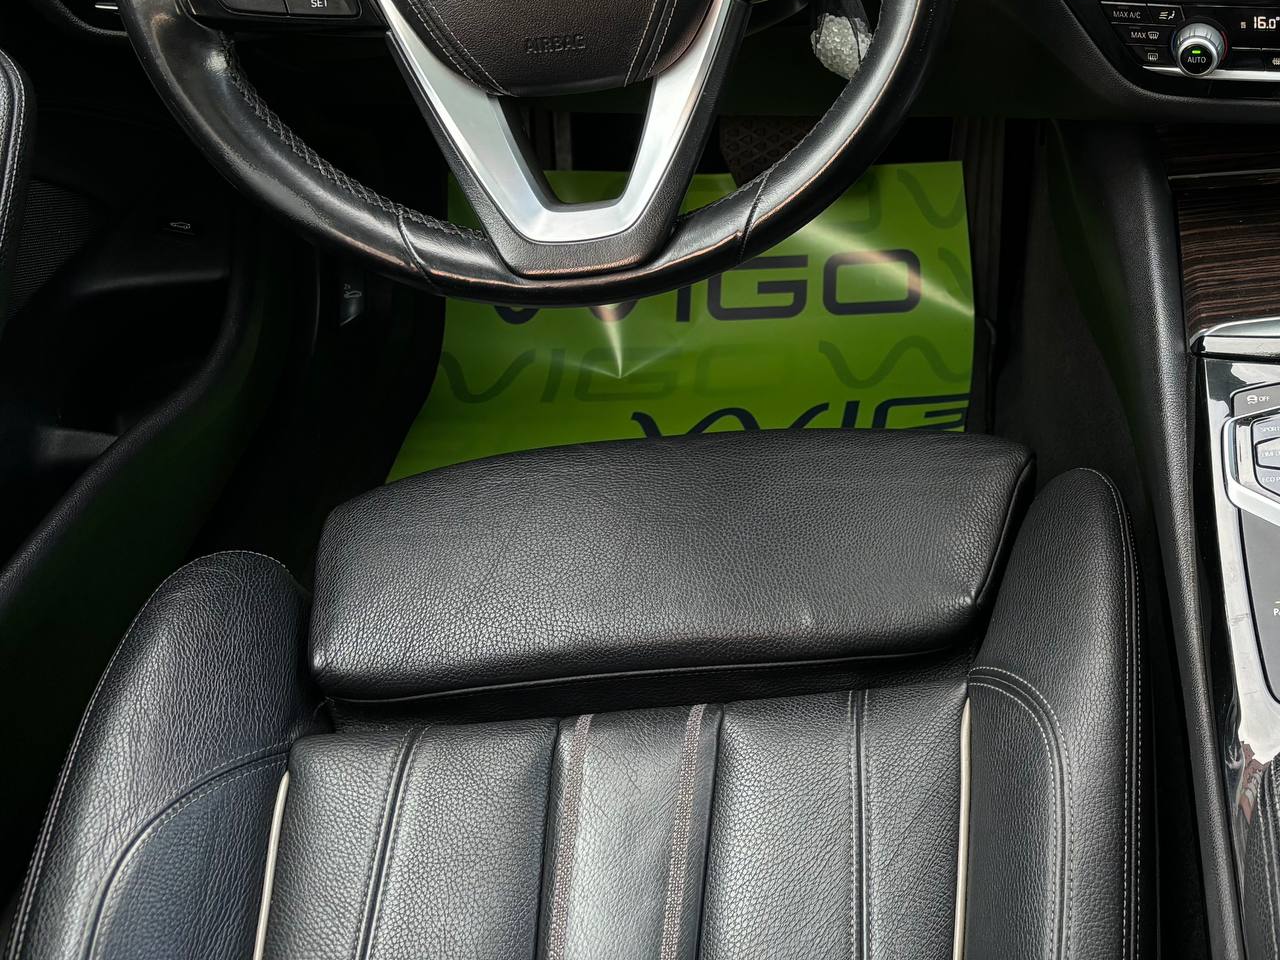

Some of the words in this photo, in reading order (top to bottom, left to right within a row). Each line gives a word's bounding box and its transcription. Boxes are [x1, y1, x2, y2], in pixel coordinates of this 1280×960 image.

[1113, 10, 1128, 18] MAX
[1129, 11, 1141, 19] A/C
[1130, 31, 1146, 39] MAX
[524, 34, 586, 54] AIRBAG
[1187, 56, 1207, 64] AUTO
